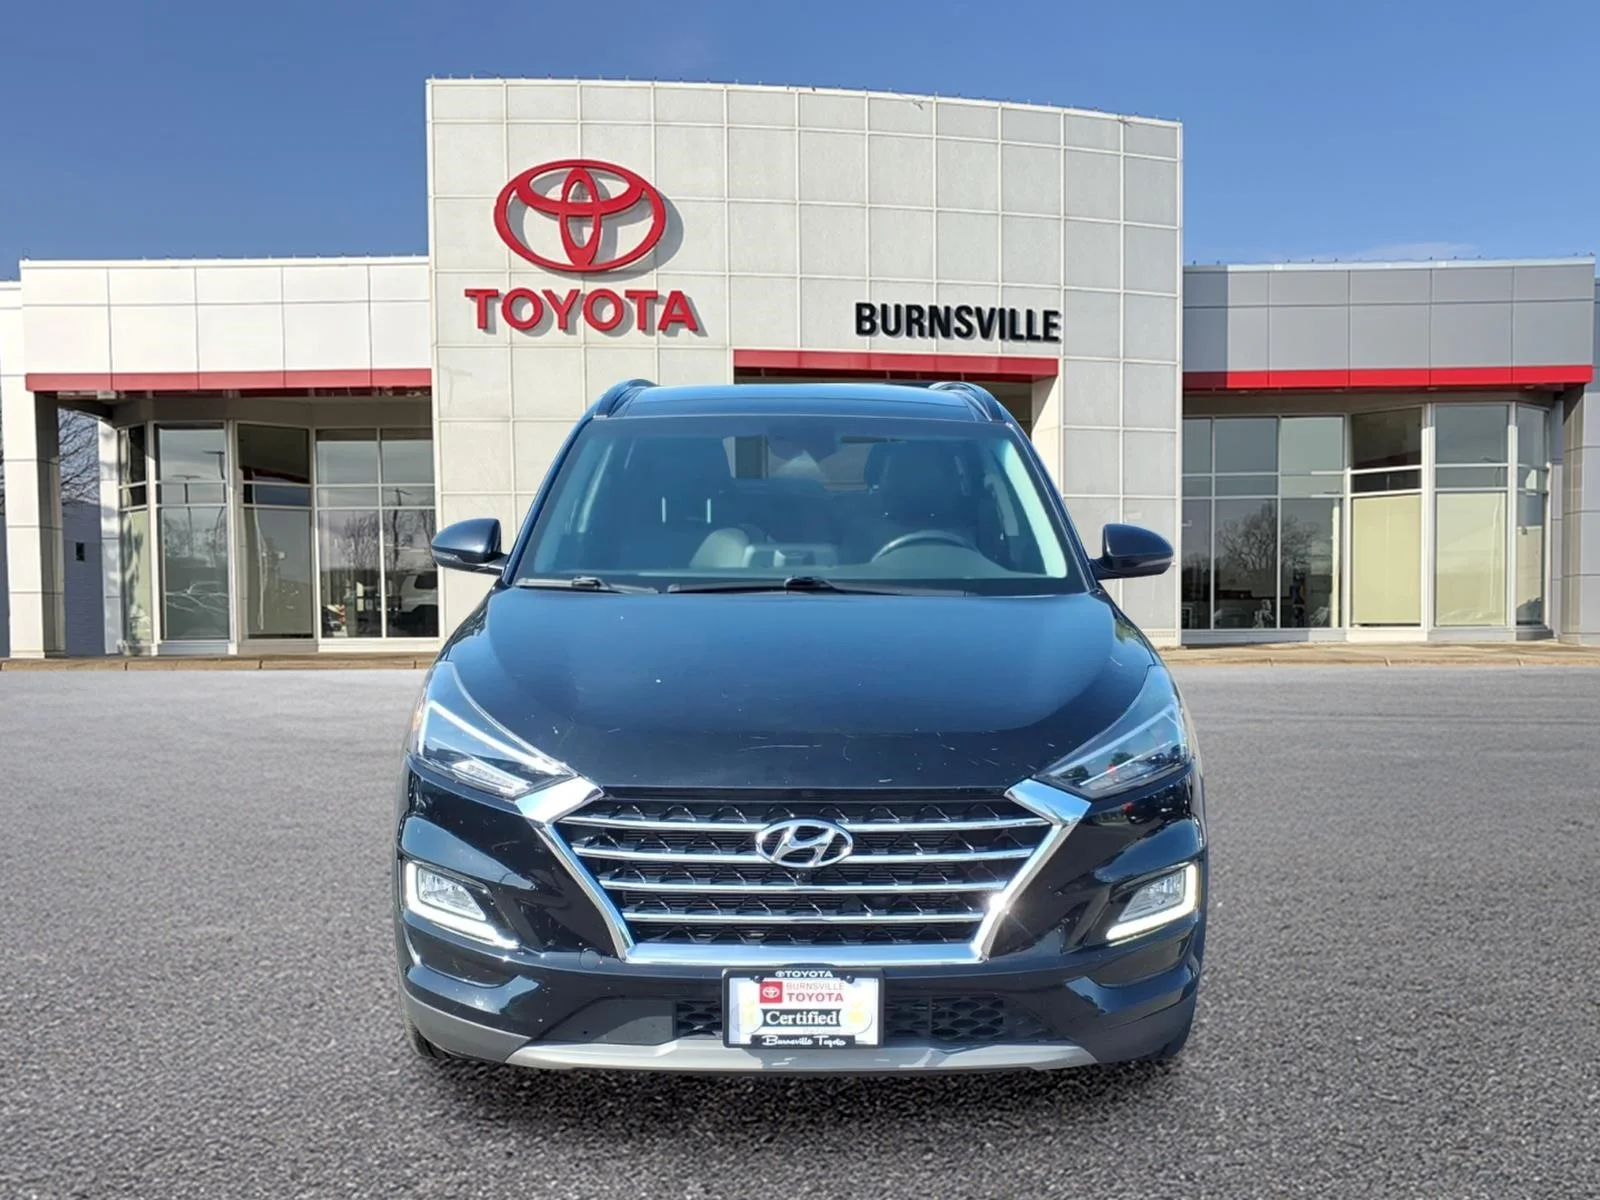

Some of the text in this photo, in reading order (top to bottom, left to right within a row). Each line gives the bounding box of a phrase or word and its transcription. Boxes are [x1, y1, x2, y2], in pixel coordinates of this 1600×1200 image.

[464, 287, 698, 332] TOYOTA
[855, 302, 1060, 342] BURNSVILLE
[785, 970, 833, 978] TOYOTA
[786, 982, 844, 990] BURNSVILLE
[787, 992, 844, 1002] TOYOTA
[765, 1010, 837, 1025] Certified
